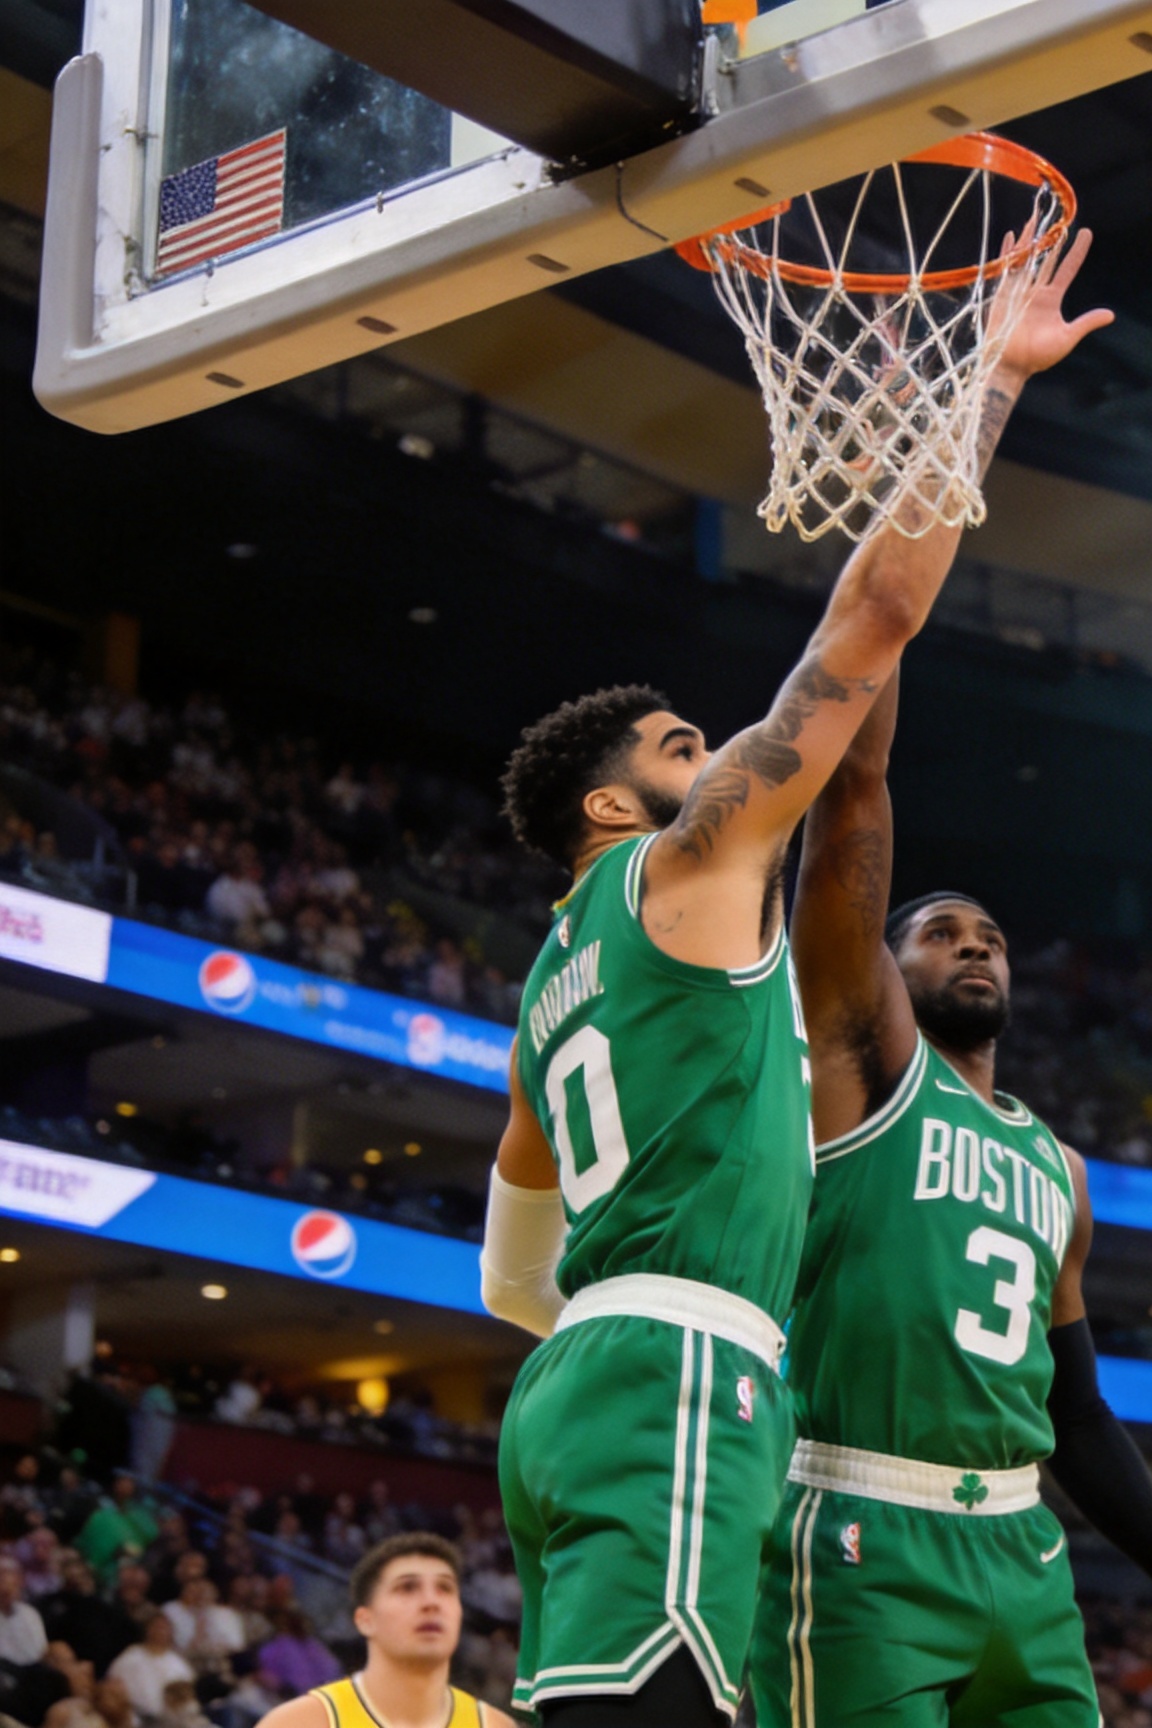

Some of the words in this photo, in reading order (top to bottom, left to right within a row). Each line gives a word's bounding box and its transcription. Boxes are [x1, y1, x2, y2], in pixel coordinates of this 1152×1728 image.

[545, 1024, 630, 1215] 0
[913, 1117, 1072, 1273] BOSTON
[954, 1225, 1036, 1366] 3
